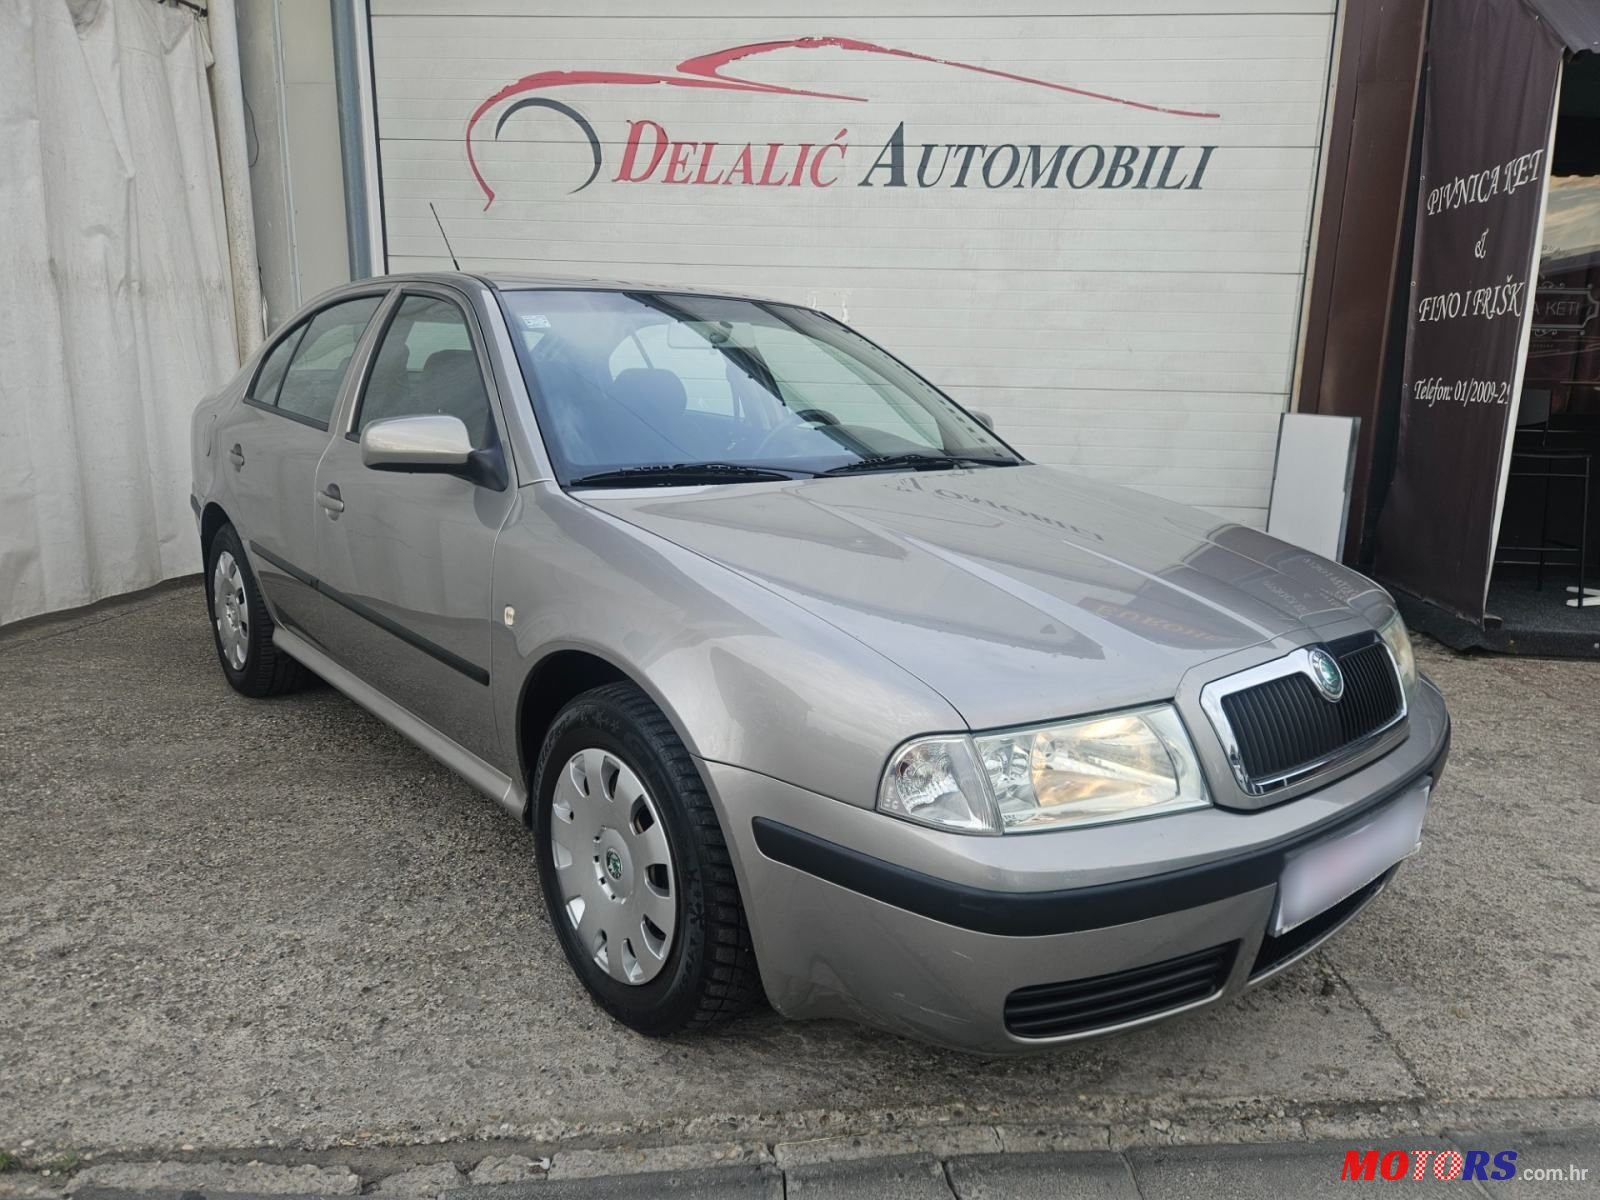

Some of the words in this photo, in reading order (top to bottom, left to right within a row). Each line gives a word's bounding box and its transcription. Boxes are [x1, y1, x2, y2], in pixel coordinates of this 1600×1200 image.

[611, 120, 847, 187] DELALIĆ
[858, 121, 1217, 190] AUTOMOBILI
[1427, 166, 1499, 215] PIVNICA
[1474, 228, 1489, 259] &
[1419, 292, 1461, 322] FINO
[1414, 377, 1453, 407] Telefon:
